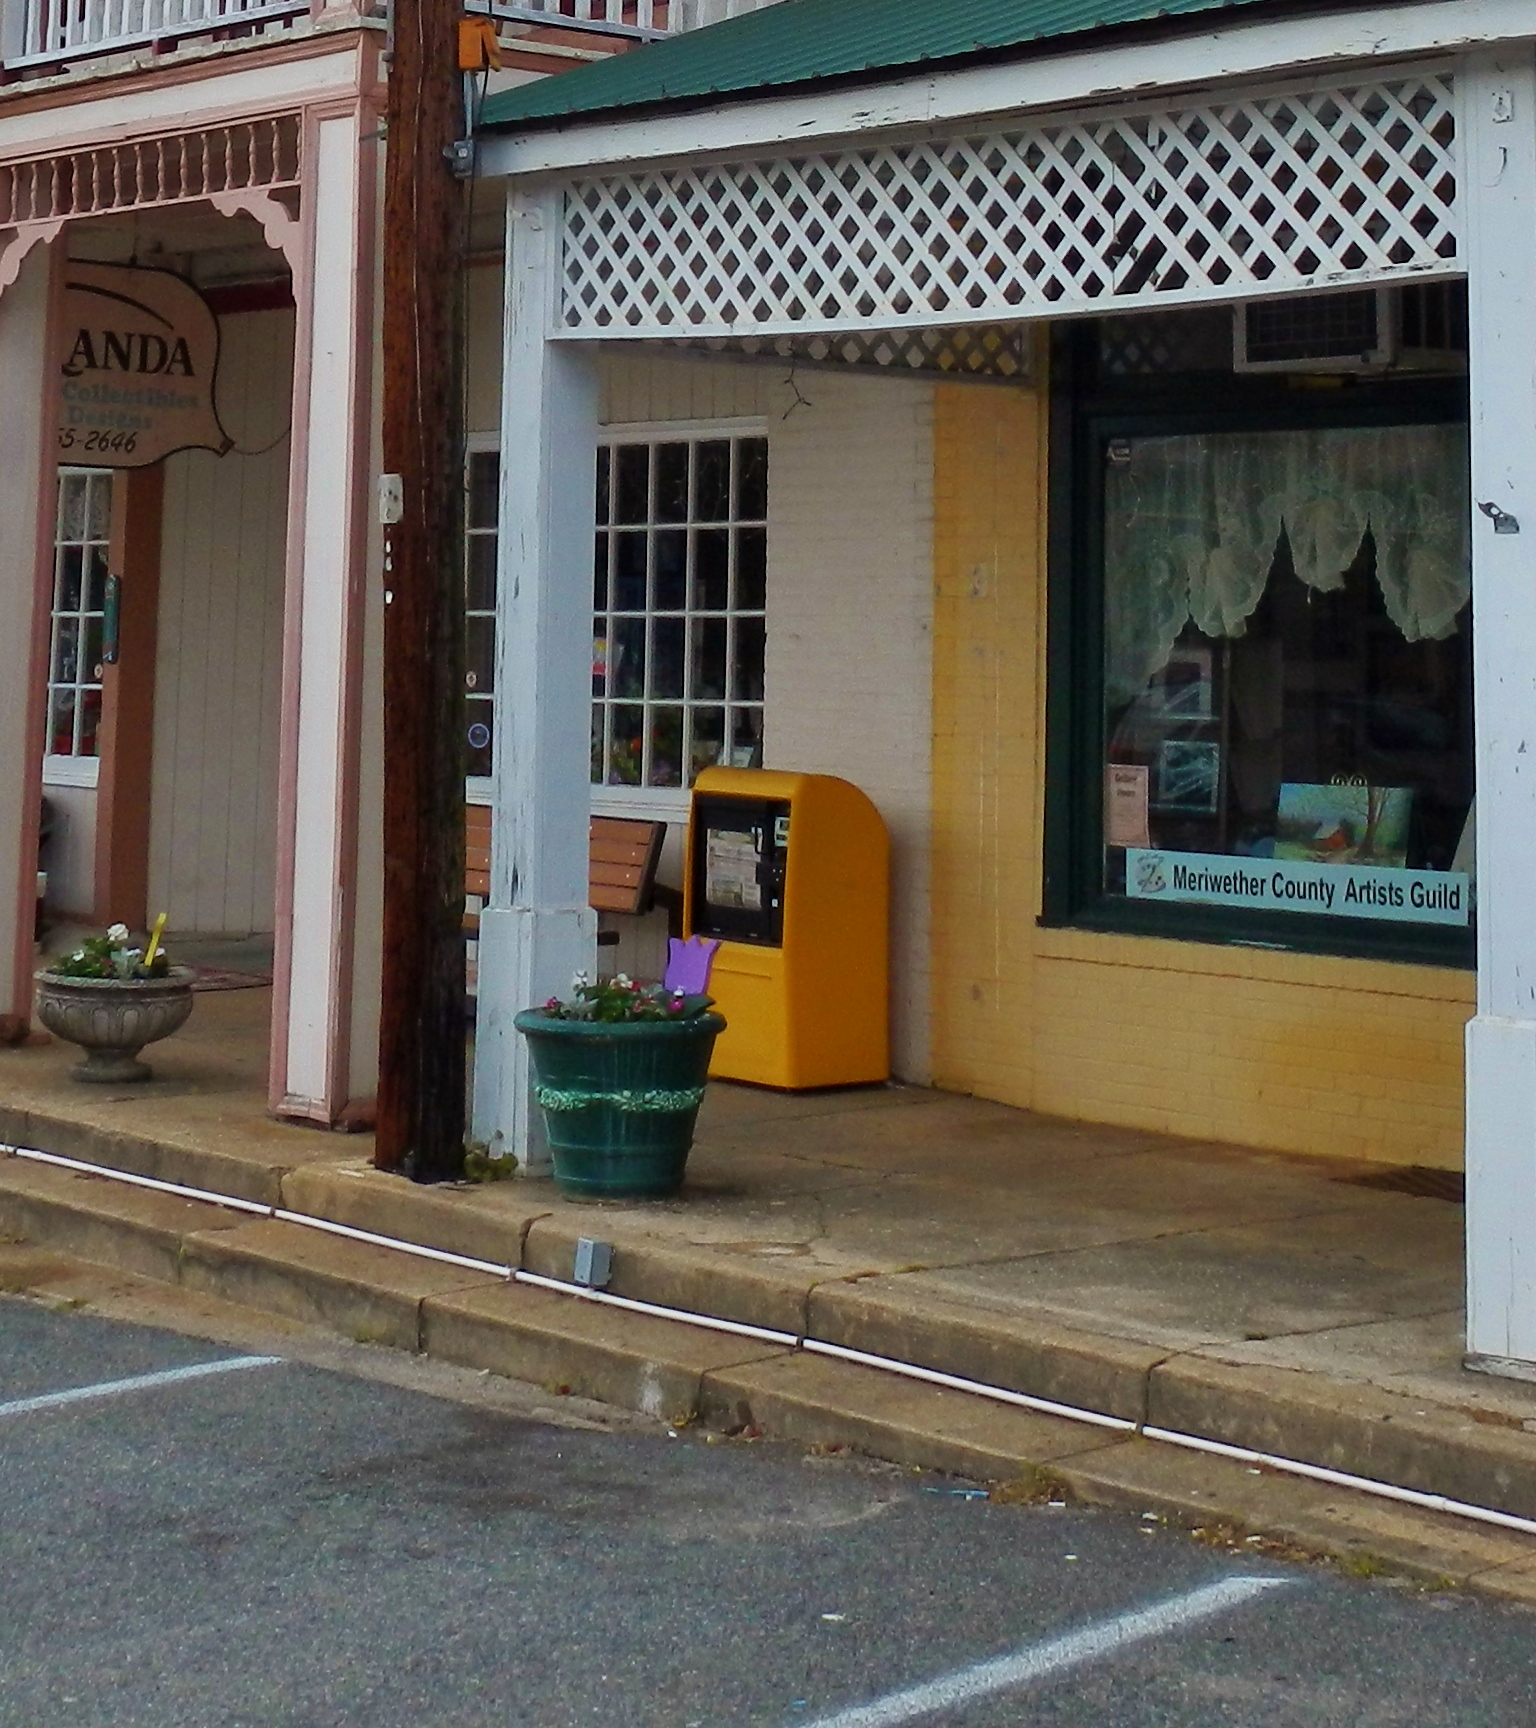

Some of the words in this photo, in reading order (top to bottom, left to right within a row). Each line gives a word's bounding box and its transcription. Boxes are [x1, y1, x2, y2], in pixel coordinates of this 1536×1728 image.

[61, 328, 195, 377] ANDA
[1173, 865, 1266, 897] Meriwether
[1272, 873, 1335, 909] County
[1344, 878, 1404, 907] Artists
[1410, 881, 1460, 911] Guild
